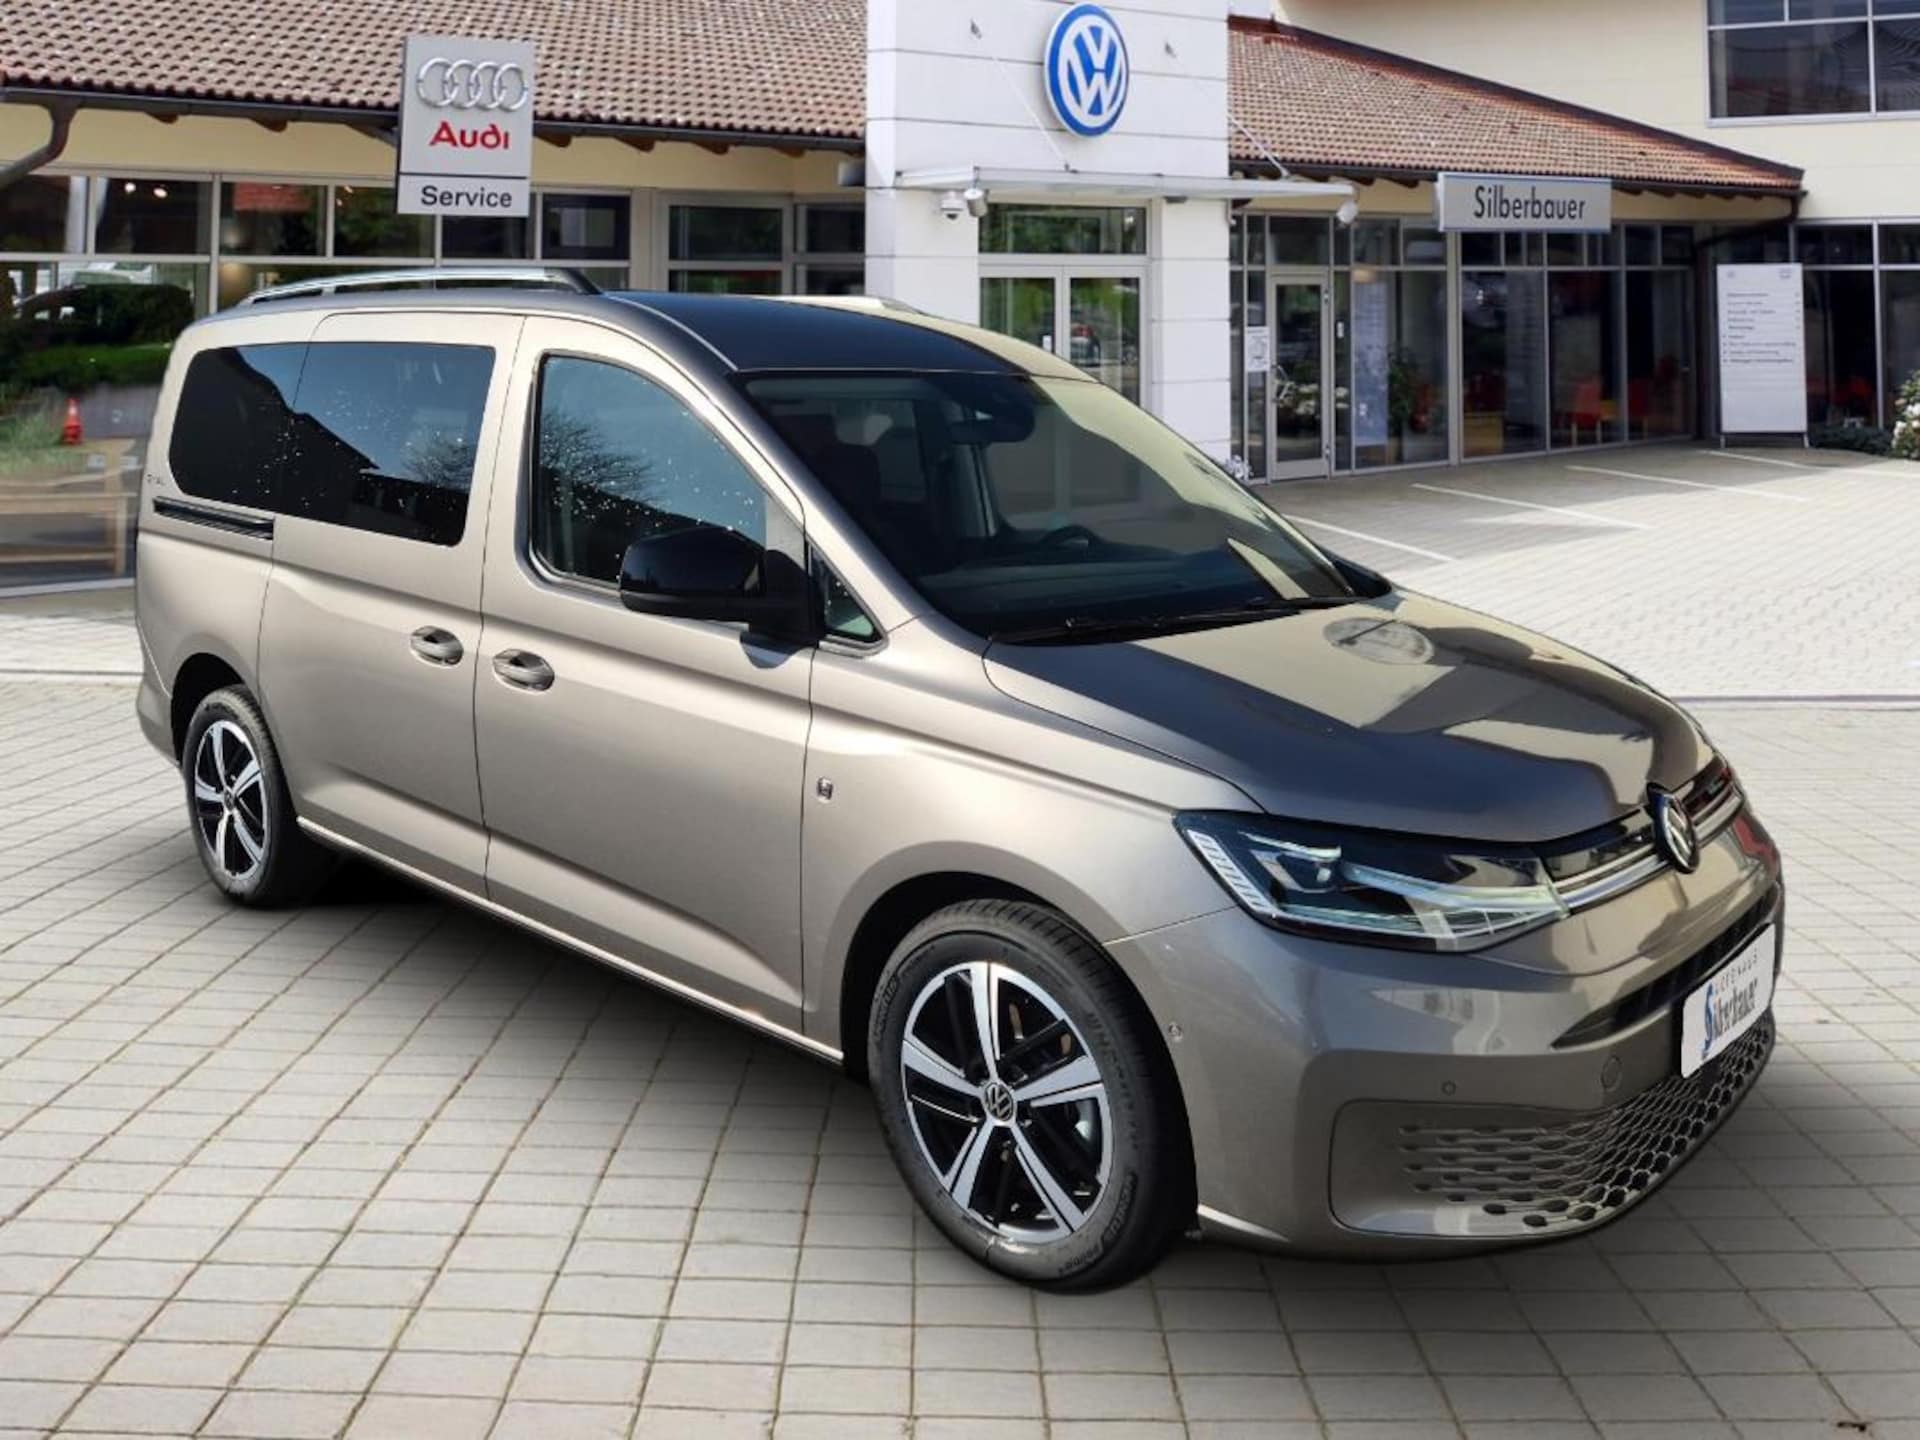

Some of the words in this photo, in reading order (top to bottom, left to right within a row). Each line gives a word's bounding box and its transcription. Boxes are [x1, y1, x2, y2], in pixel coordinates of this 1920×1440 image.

[429, 120, 511, 150] Audi
[420, 184, 513, 208] Service
[1473, 184, 1586, 220] Silberbauer
